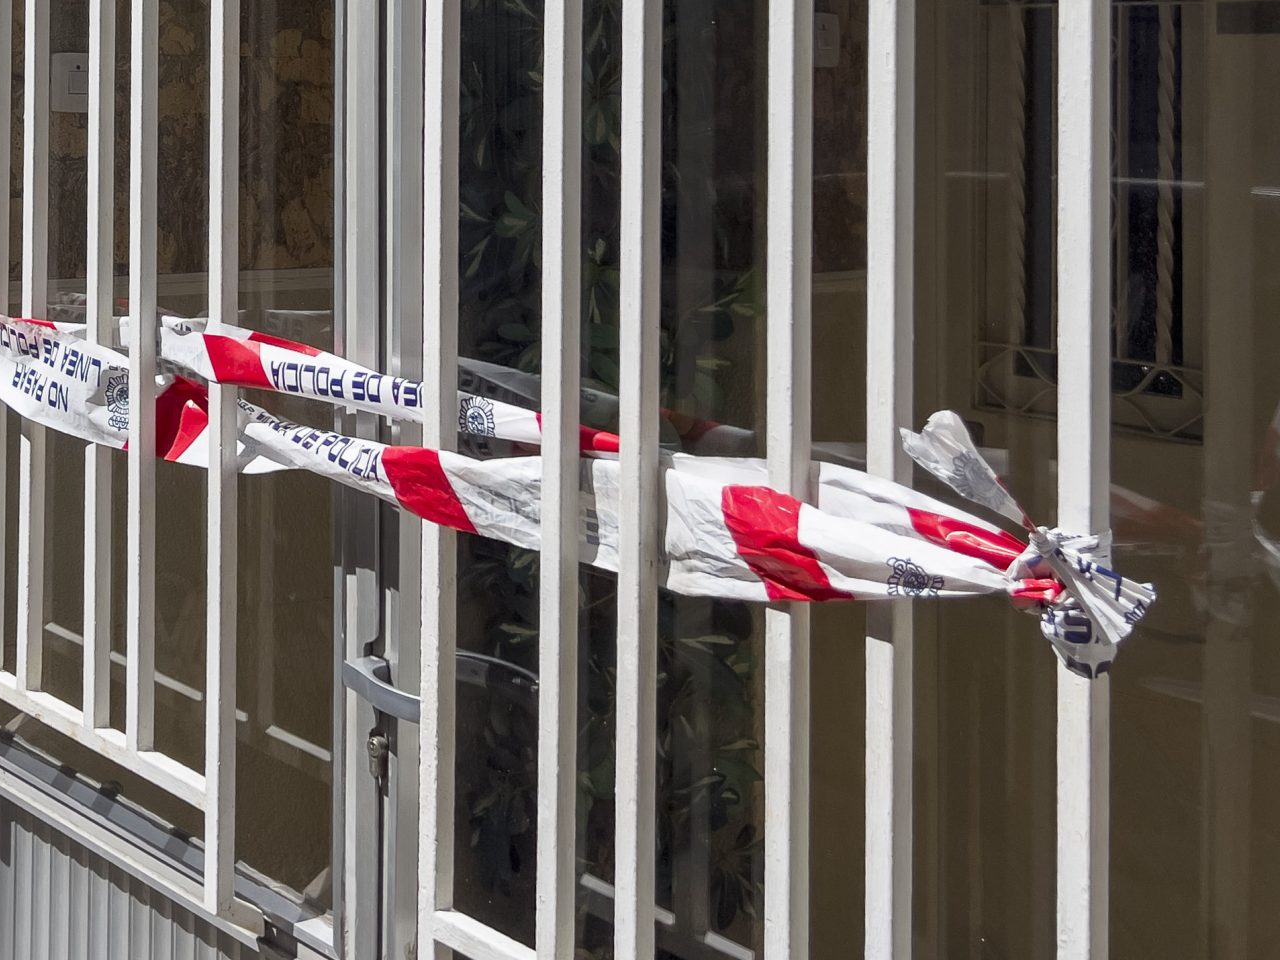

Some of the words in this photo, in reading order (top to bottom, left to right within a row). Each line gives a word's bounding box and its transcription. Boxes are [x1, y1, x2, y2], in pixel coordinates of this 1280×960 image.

[42, 338, 60, 368] DE
[60, 346, 101, 388] LINEA
[12, 362, 48, 402] PASAR
[48, 380, 68, 413] NO
[271, 360, 347, 399] POLICIA
[352, 362, 382, 404] DE
[291, 426, 321, 450] DE
[315, 433, 381, 482] POLICIA
